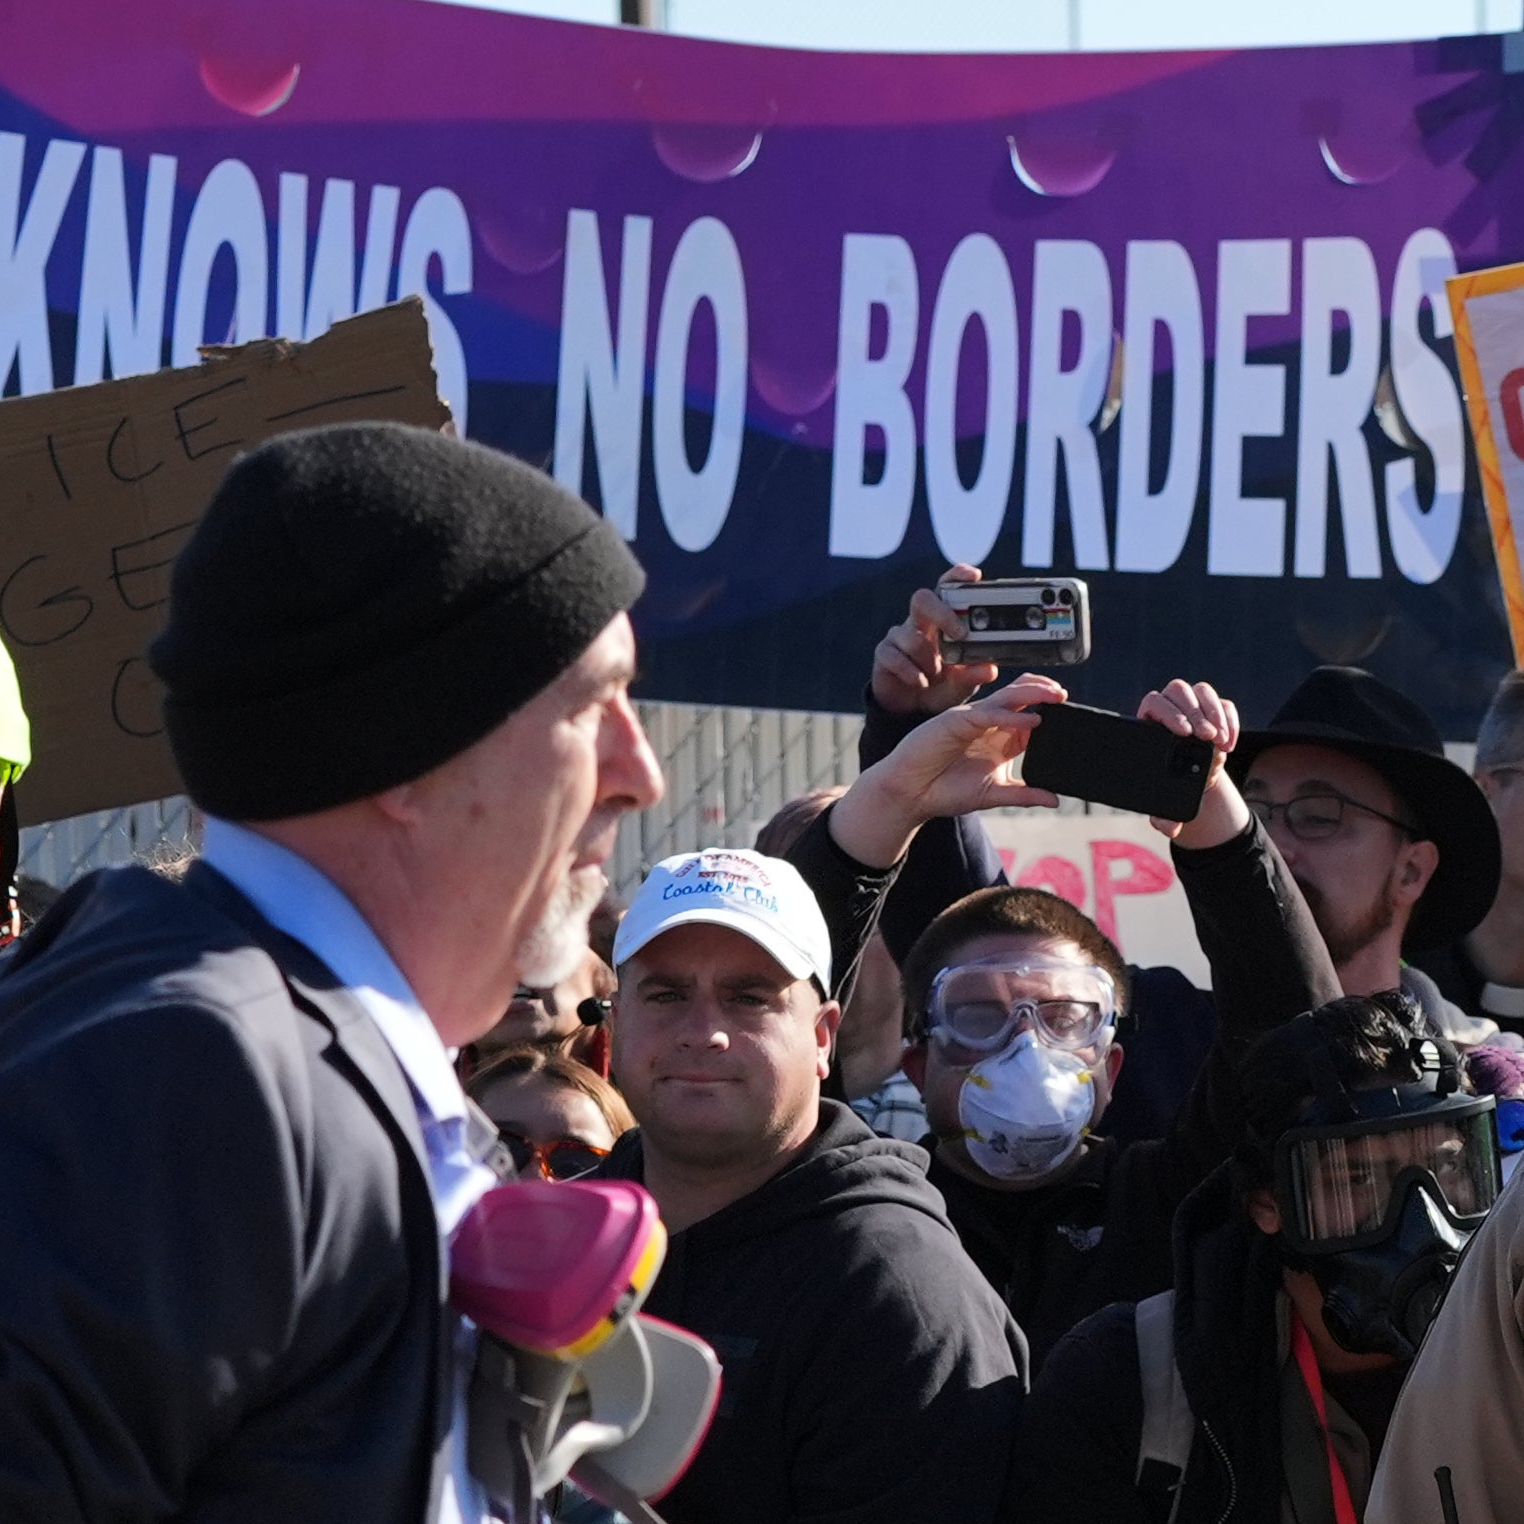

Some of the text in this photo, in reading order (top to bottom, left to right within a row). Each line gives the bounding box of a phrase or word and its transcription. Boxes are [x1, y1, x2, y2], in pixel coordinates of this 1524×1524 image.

[47, 378, 245, 499] ICE
[553, 209, 748, 552] NO
[828, 228, 1465, 584] BORDERS
[0, 521, 197, 646] GE
